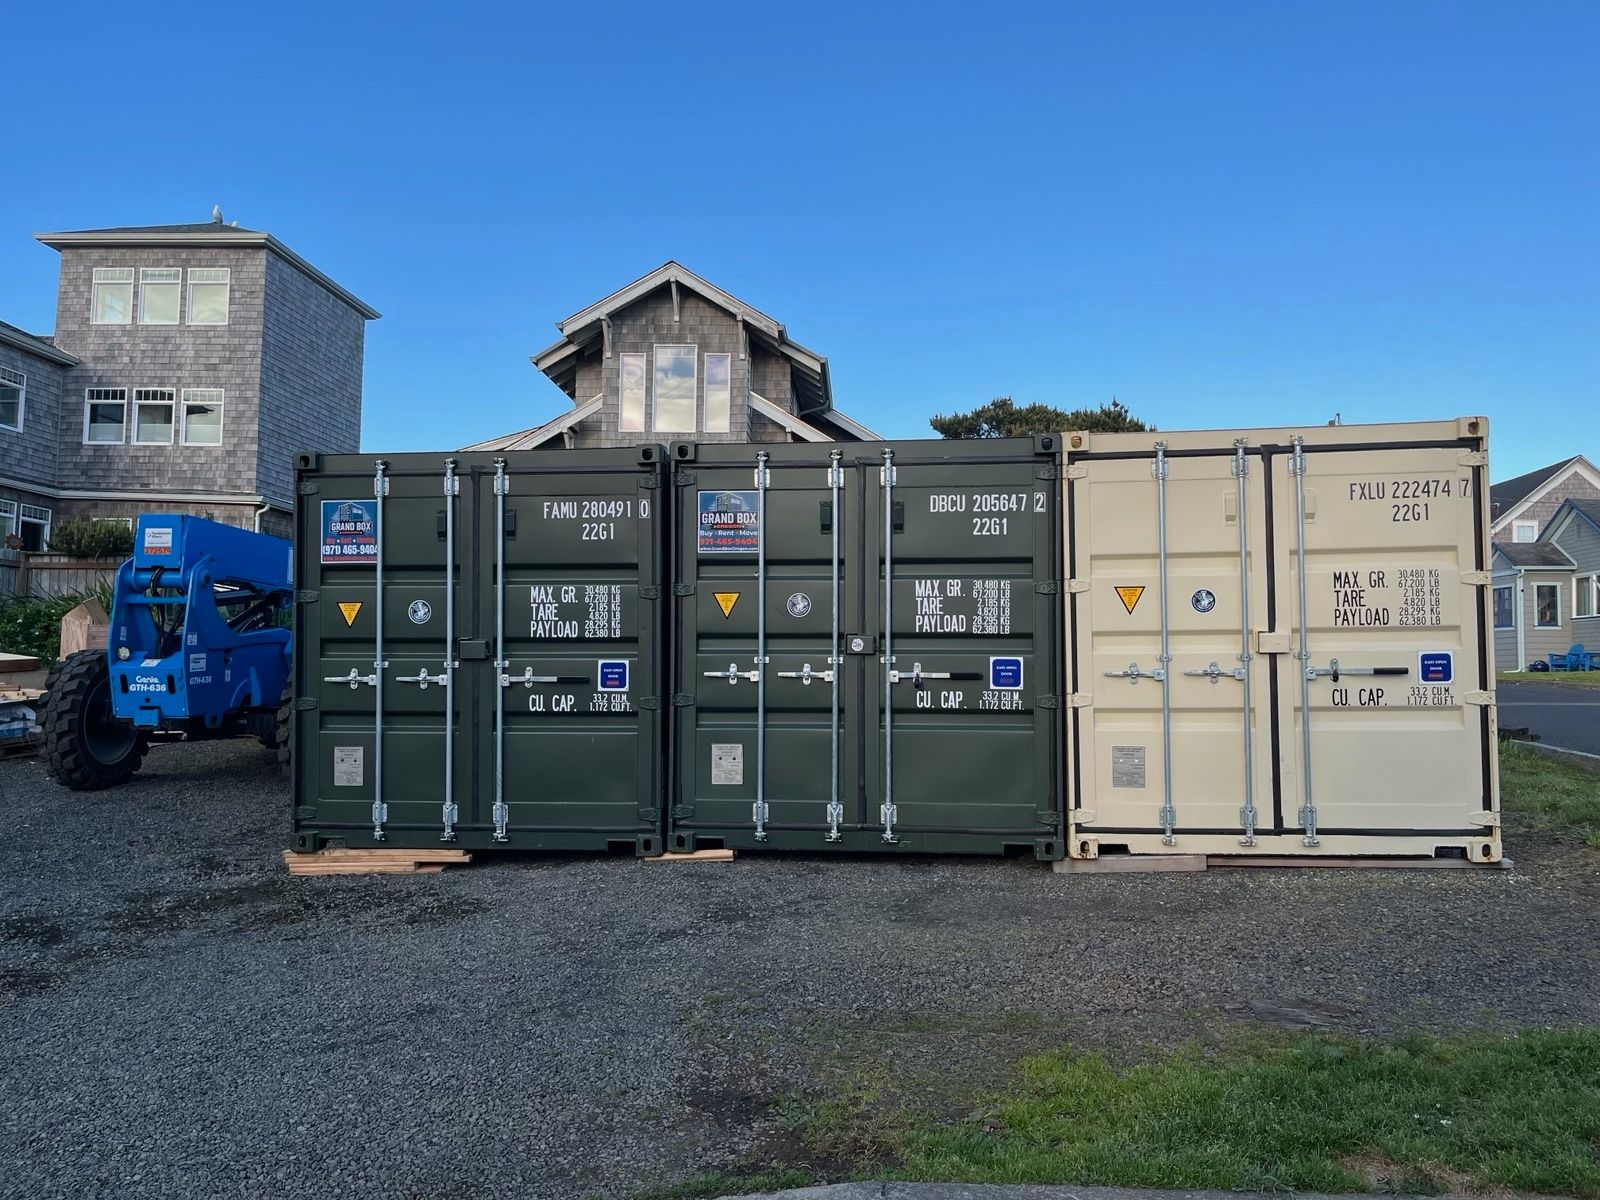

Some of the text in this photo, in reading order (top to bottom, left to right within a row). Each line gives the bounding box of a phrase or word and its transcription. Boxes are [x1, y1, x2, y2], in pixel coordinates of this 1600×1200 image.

[1349, 479, 1470, 500] FXLU 222474 7
[929, 494, 1044, 512] DBCU 205647 2
[543, 500, 649, 519] FAMU 280491 0
[1392, 503, 1429, 521] 22G1
[701, 512, 757, 524] GRAND BOX
[331, 522, 371, 531] GRAND BOX
[582, 523, 614, 540] 22G1
[972, 518, 1007, 535] 22G1
[1398, 569, 1440, 578] 30.480 KG
[1000, 580, 1010, 589] KG
[1333, 571, 1389, 589] MAX. GR.
[1398, 578, 1440, 588] 67.200 LB
[584, 585, 620, 594] 30.480 KG
[915, 580, 966, 597] MAX. GR.
[1000, 589, 1010, 598] LB
[1403, 588, 1440, 597] 2.185 KG
[530, 586, 578, 603] MAX. GR.
[584, 594, 620, 603] 67.200 LB
[1334, 590, 1366, 607] TARE
[915, 597, 944, 615] TARE
[1000, 598, 1010, 607] KG
[1403, 597, 1440, 606] 4.820 LB
[530, 603, 559, 620] TARE
[589, 603, 620, 612] 2.185 KG
[1000, 607, 1010, 616] LB
[1399, 607, 1441, 616] 28.295 KG
[589, 611, 620, 620] 4.820 LB
[1000, 616, 1010, 625] KG
[1334, 608, 1390, 626] PAYLOAD
[1399, 616, 1441, 625] 62.380 LB
[584, 620, 620, 629] 28.295 KG
[915, 615, 967, 633] PAYLOAD
[530, 621, 578, 638] PAYLOAD
[584, 629, 620, 638] 62.380 LB
[1000, 625, 1010, 634] LB
[129, 684, 167, 692] GTH-636
[916, 691, 967, 709] CU. CAP.
[1332, 689, 1388, 706] CU. CAP.
[1407, 696, 1428, 706] 1.172
[528, 694, 577, 712] CU. CAP.
[589, 702, 632, 712] 1.172 CU.FT.
[979, 700, 999, 710] 1.172
